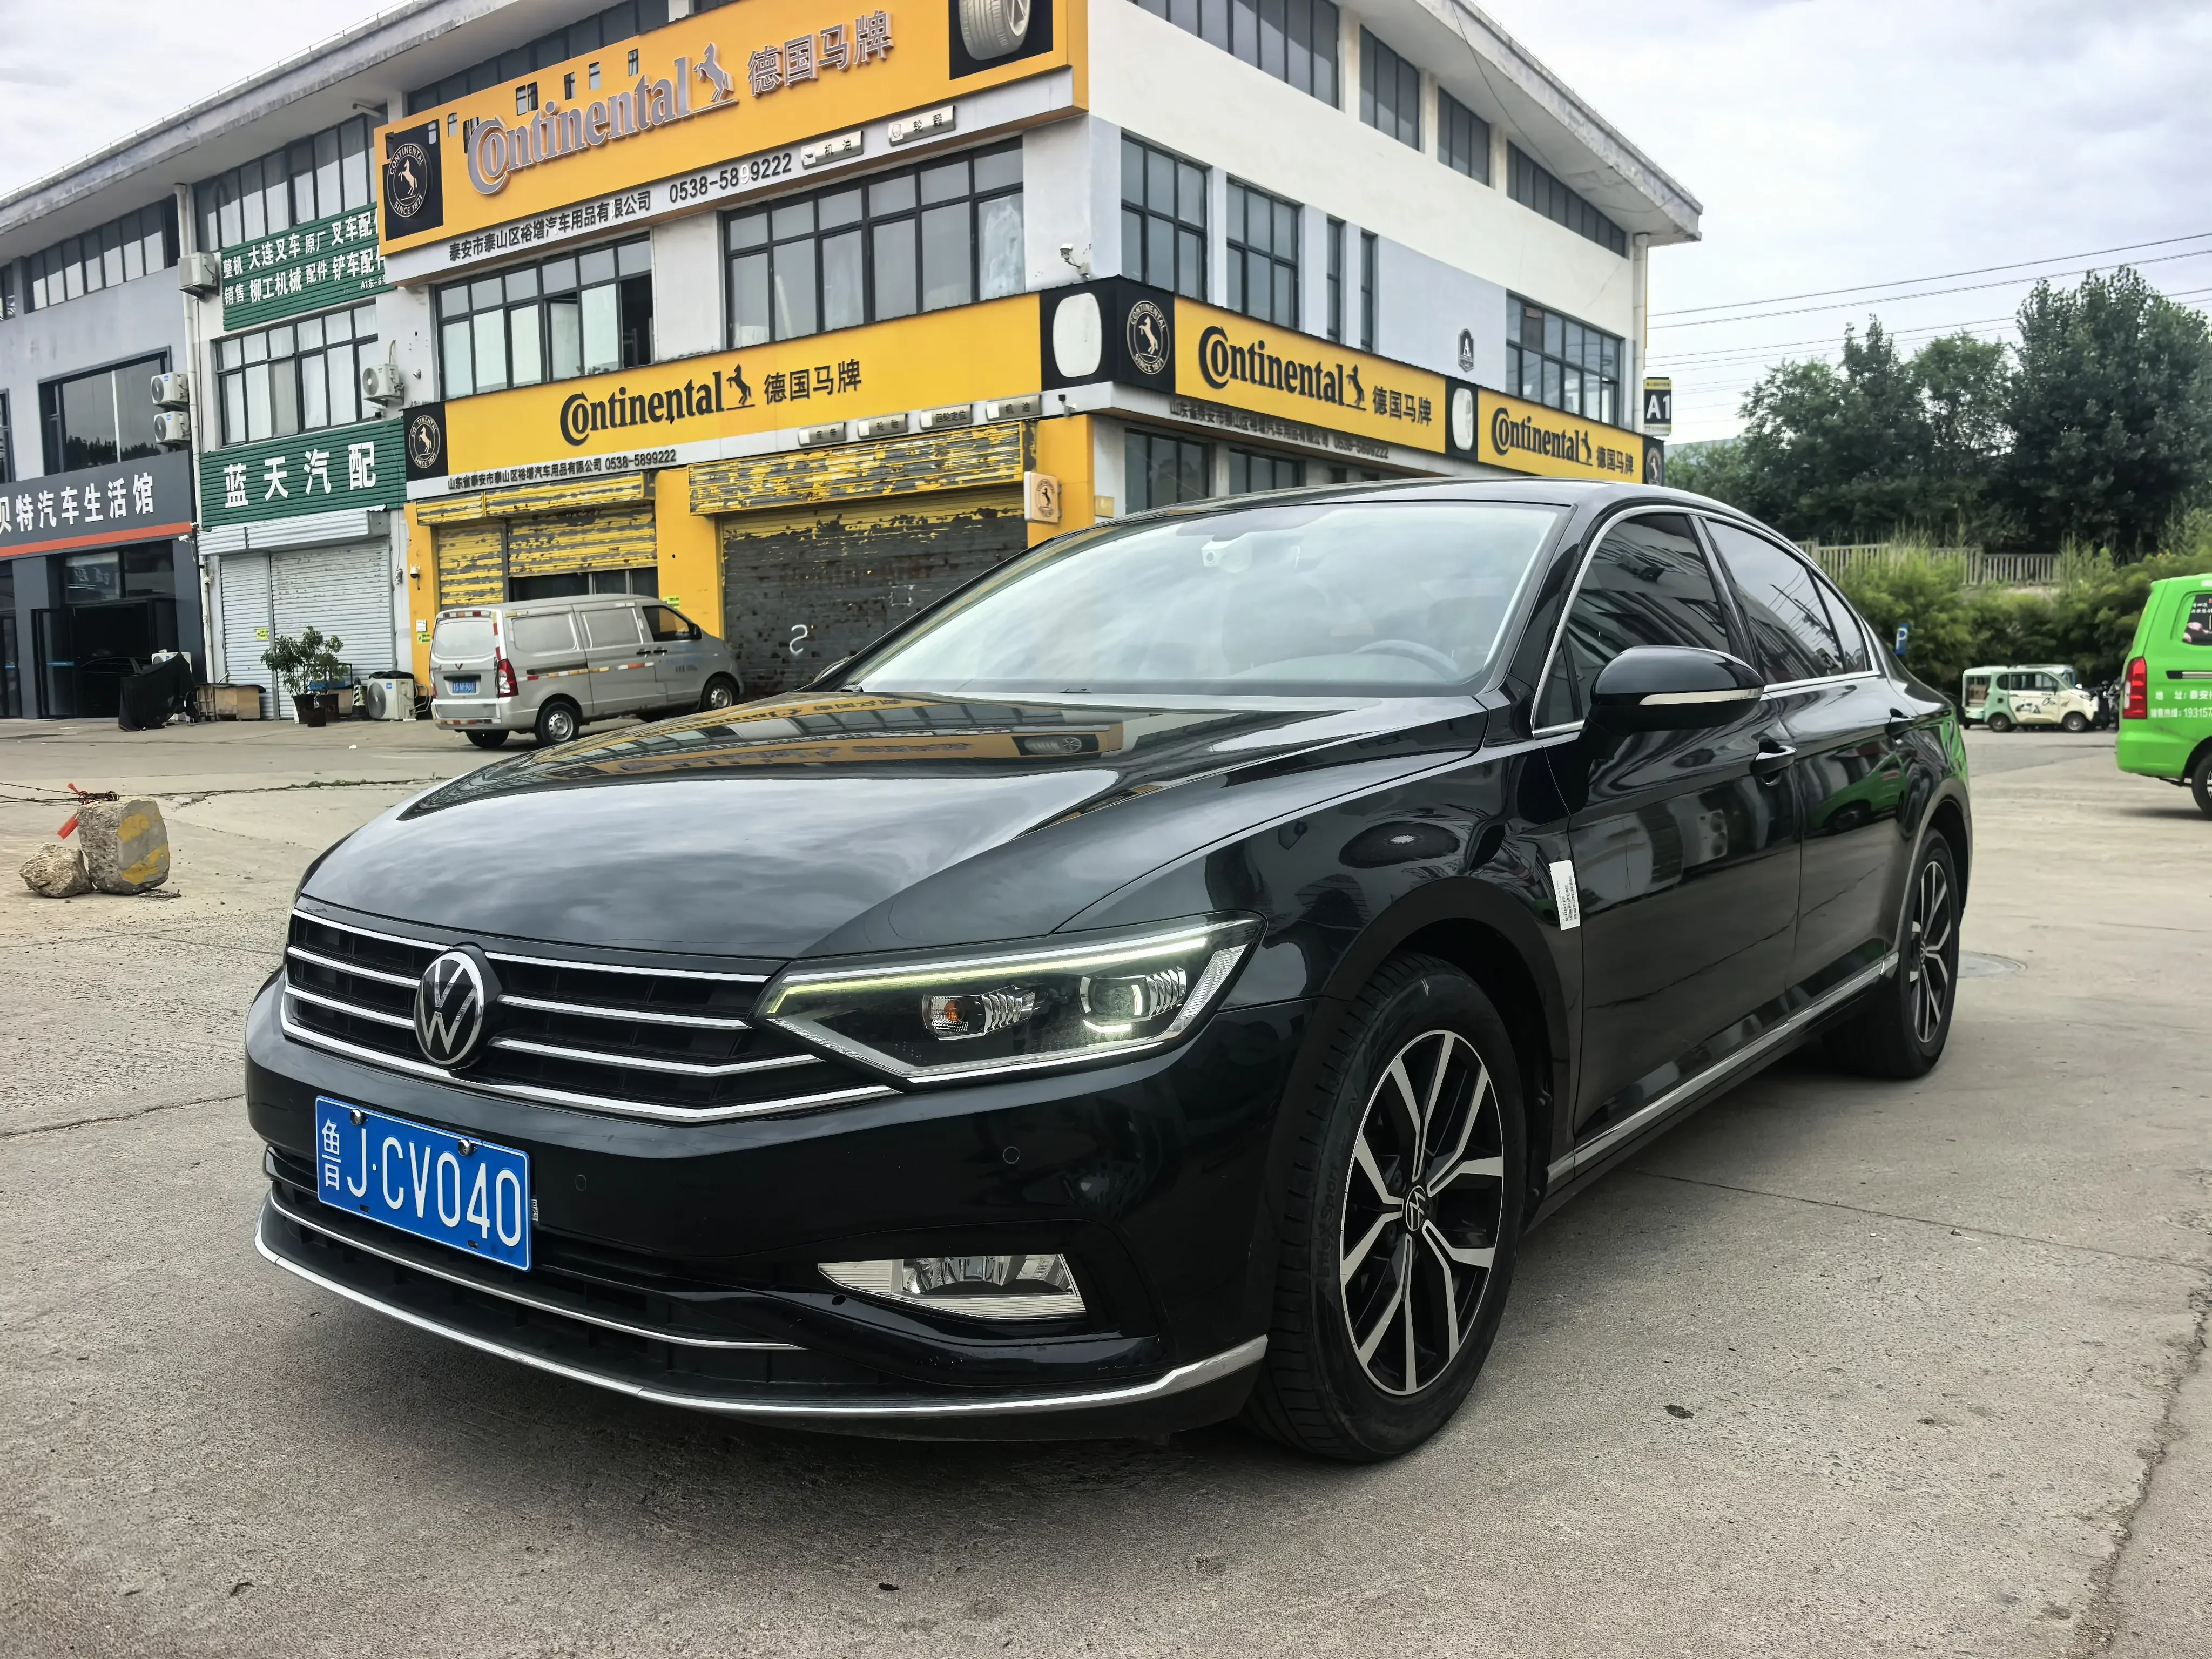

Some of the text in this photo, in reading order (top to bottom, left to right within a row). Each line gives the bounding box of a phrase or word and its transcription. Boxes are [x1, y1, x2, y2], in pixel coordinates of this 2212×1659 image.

[747, 9, 893, 97] 德国马牌
[467, 56, 692, 195] Continental
[824, 139, 853, 156] 机油
[394, 201, 411, 215] SINCE
[223, 255, 243, 279] 整机
[248, 233, 301, 270] 大连叉车
[305, 231, 326, 254] 原厂
[224, 282, 245, 306] 销售
[249, 266, 302, 303] 柳工机械
[306, 258, 328, 285] 配件
[764, 358, 862, 406] 德国马牌
[1198, 326, 1345, 406] Continental
[410, 416, 437, 437] COTINENTAL
[559, 370, 725, 446] Continental
[1372, 385, 1432, 427] 德国马牌
[1646, 394, 1671, 419] A1
[1491, 407, 1580, 463] Continental
[224, 441, 377, 508] 蓝天汽配
[604, 448, 677, 471] 0538-5899222
[1596, 445, 1634, 477] 德国马牌
[1896, 628, 1908, 649] P
